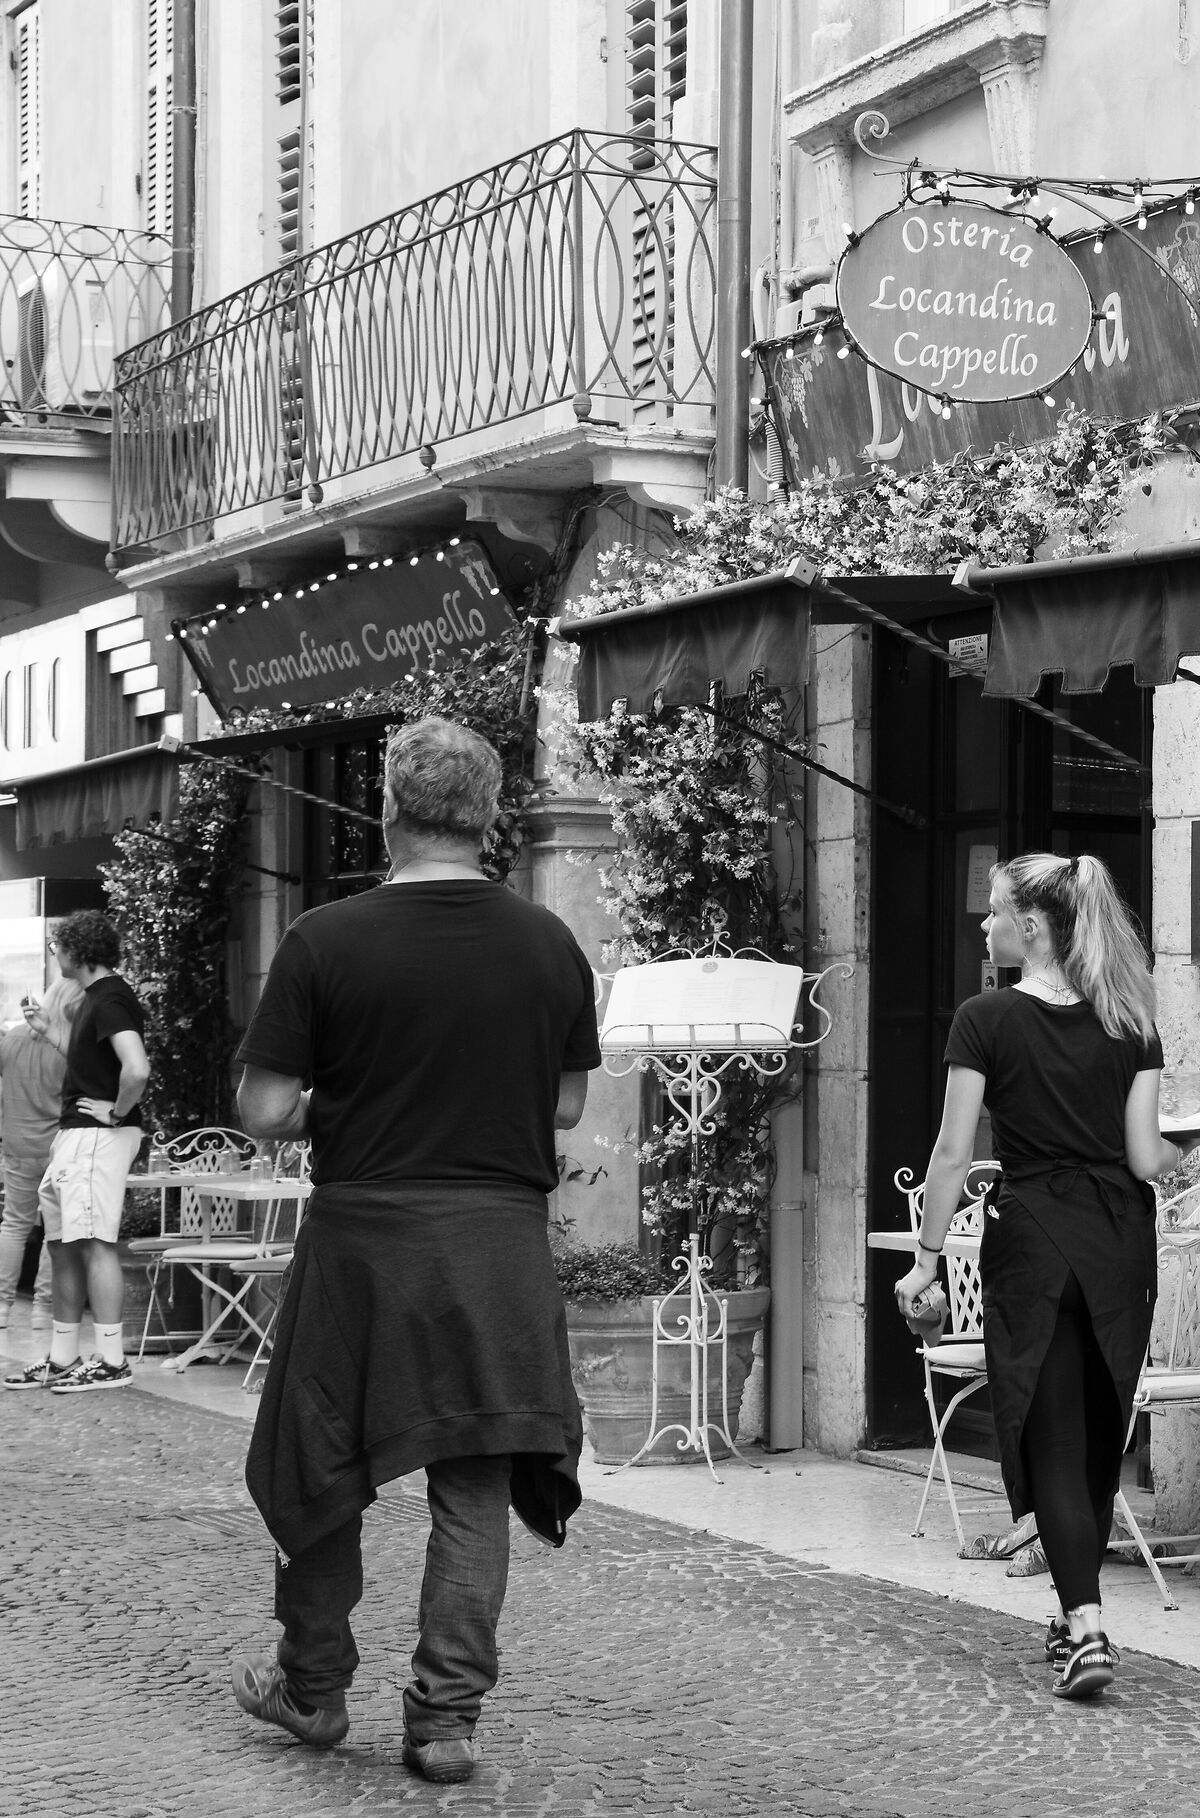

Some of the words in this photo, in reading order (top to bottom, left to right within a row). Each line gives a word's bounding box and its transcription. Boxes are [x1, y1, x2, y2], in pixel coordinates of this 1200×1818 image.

[902, 216, 1033, 268] Osteria
[869, 275, 1057, 326] Locandina
[894, 331, 1038, 389] Cappello
[229, 630, 361, 694] Locandina
[361, 589, 486, 674] Cappello
